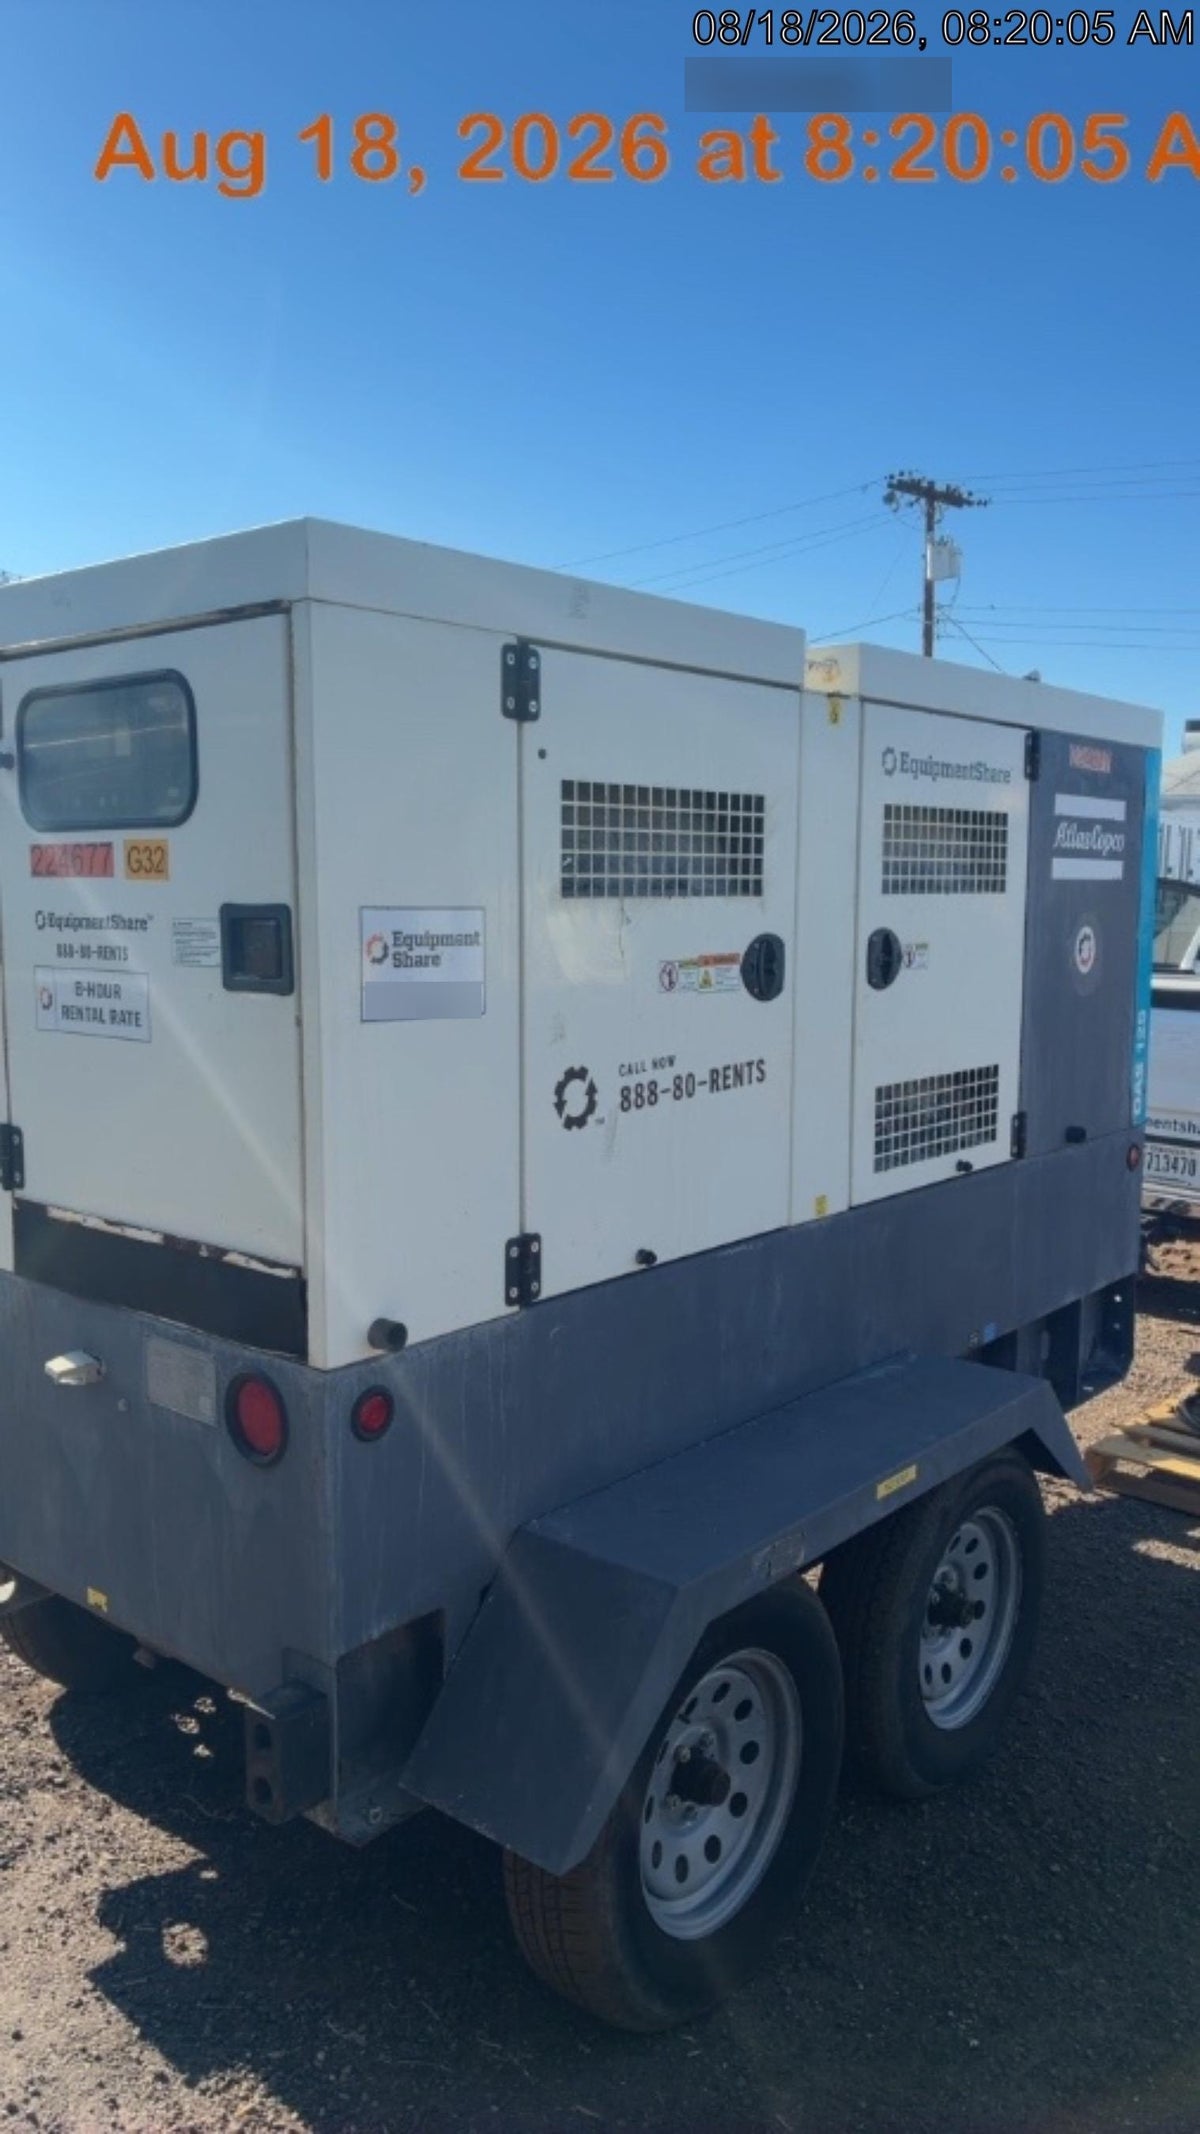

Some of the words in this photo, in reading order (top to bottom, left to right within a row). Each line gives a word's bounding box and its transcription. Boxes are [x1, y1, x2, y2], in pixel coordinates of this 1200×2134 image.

[127, 845, 165, 874] G32
[391, 930, 481, 951] Equipment
[392, 950, 442, 969] Share
[61, 1004, 106, 1025] RENTAL
[109, 1009, 142, 1028] RATE
[618, 1063, 648, 1078] CALL
[652, 1055, 677, 1070] NOW
[619, 1058, 767, 1113] 888-80-RENTS
